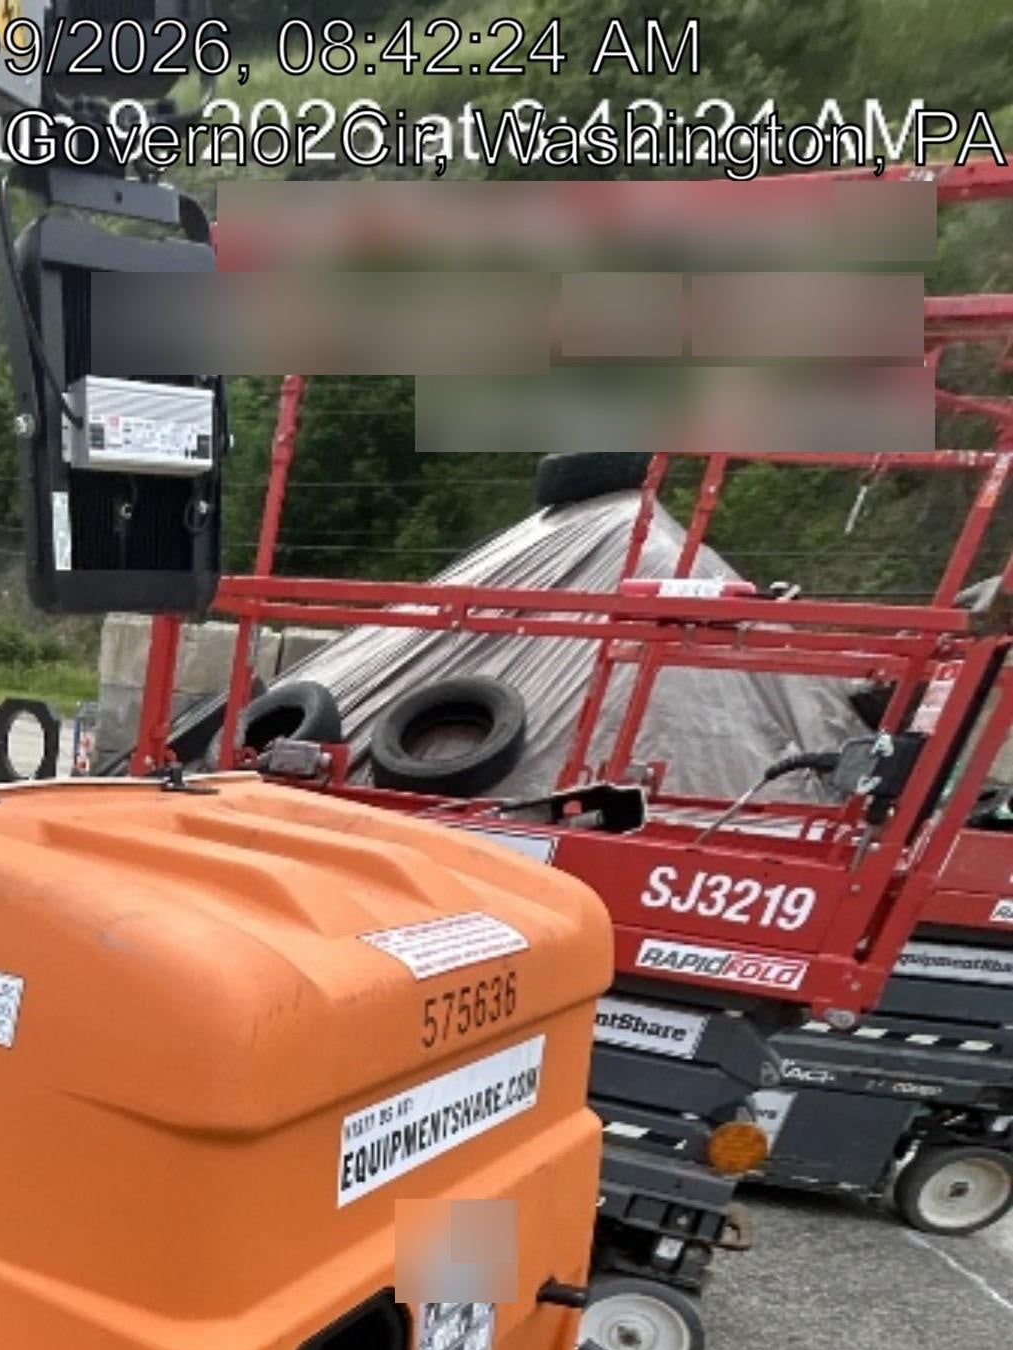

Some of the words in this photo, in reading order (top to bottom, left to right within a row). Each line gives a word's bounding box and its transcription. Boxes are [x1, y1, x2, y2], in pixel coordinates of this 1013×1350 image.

[640, 865, 817, 932] SJ3219
[421, 970, 518, 1049] 575636
[340, 1065, 538, 1192] EQUIPMENTSHARE.COM
